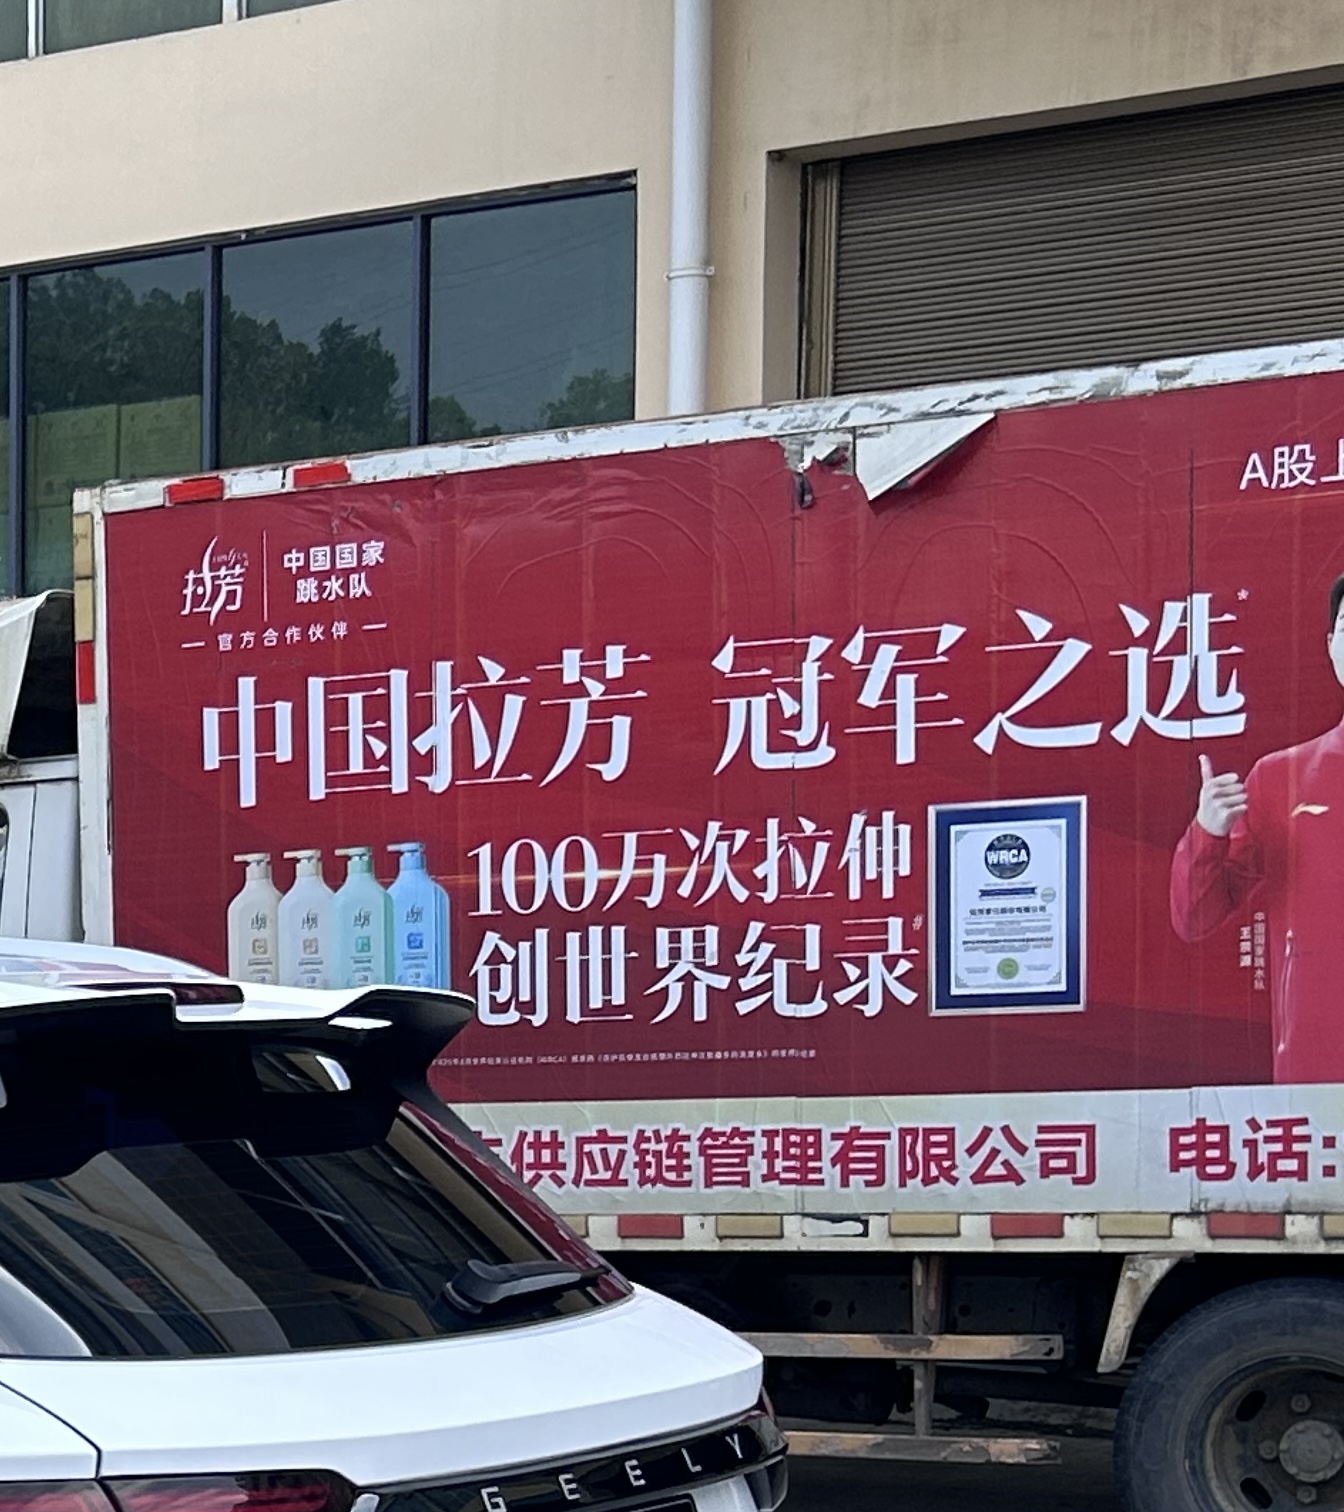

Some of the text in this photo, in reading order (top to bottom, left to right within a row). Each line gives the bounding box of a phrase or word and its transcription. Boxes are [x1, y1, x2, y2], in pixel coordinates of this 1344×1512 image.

[180, 535, 247, 627] 拉芳
[283, 540, 385, 575] 中国国家
[295, 571, 373, 604] 跳水队
[217, 621, 348, 652] 官方合作伙伴
[202, 592, 1247, 809] 中国拉芳 冠军之选
[467, 810, 912, 917] 100万次拉伸
[986, 848, 1028, 866] WRCA
[474, 1121, 1098, 1190] 供应链管理有限公司
